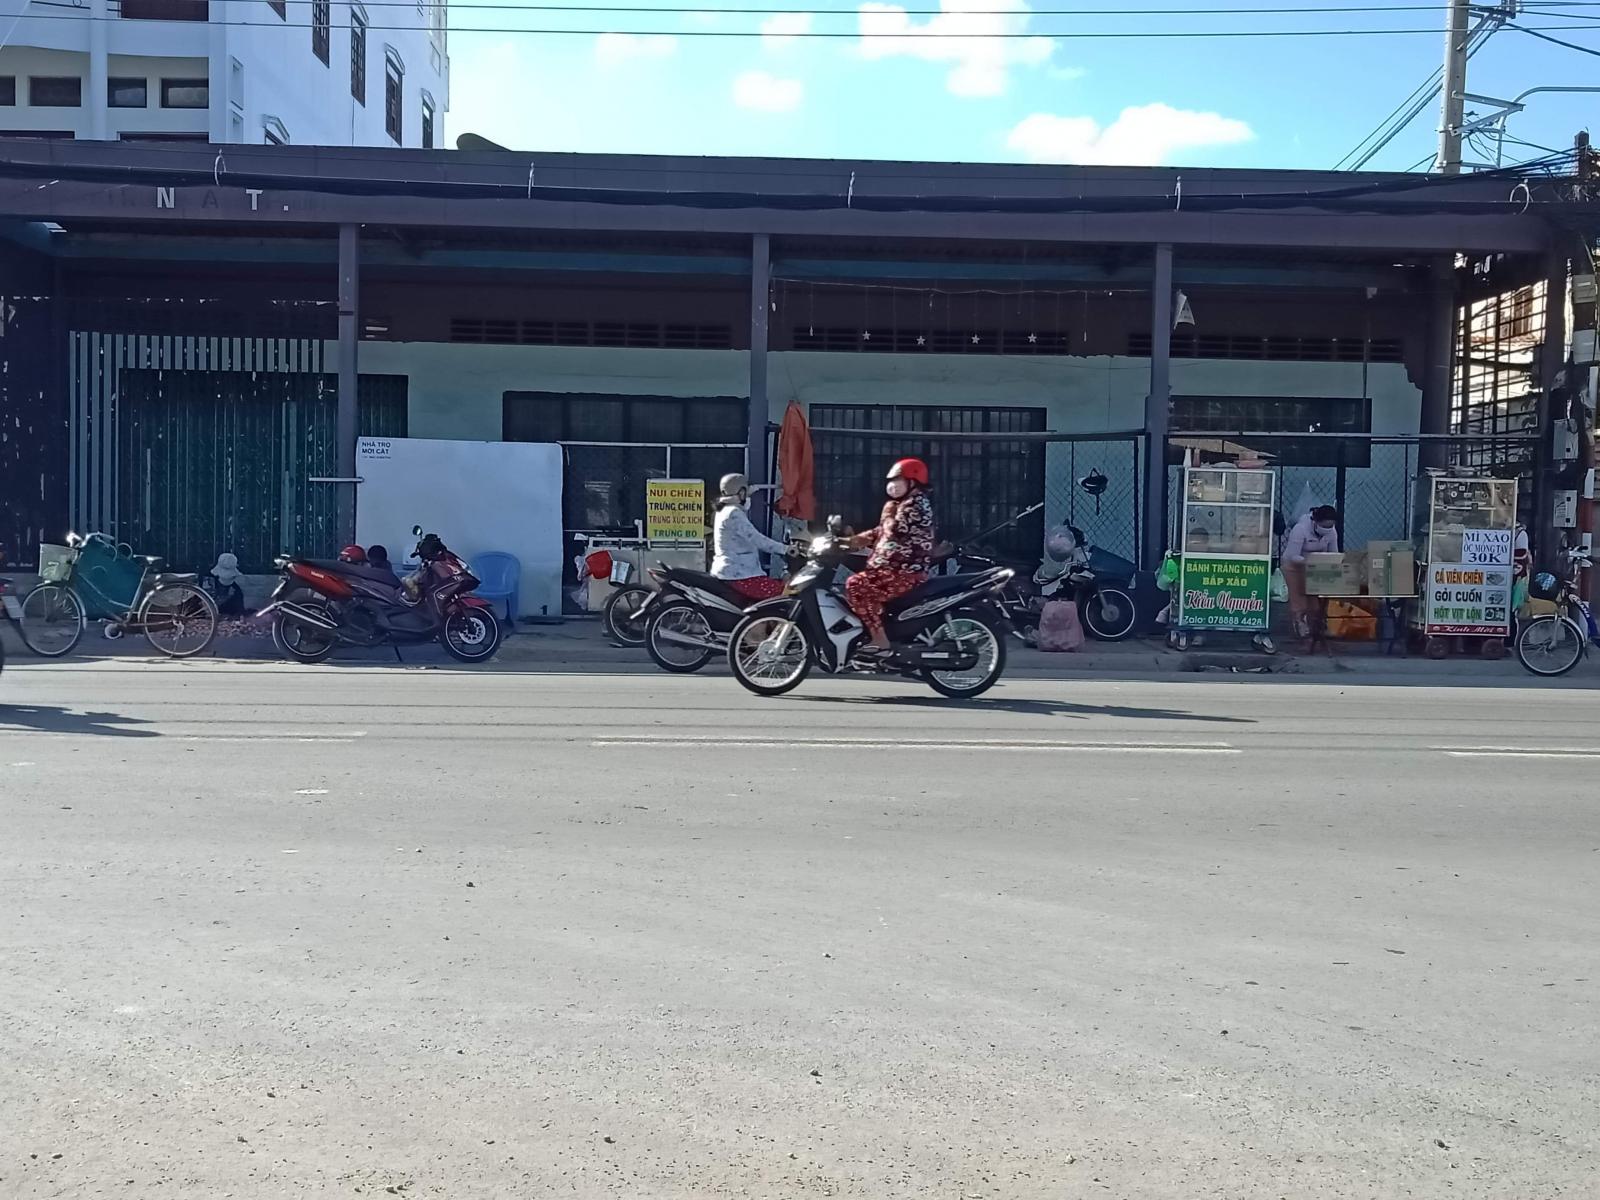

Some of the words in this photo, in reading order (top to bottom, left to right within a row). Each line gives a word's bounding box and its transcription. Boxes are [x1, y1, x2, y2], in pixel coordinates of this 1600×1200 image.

[650, 489, 667, 497] NUI
[1464, 531, 1480, 542] MÌ
[1483, 531, 1510, 543] XÀO
[1467, 552, 1502, 564] 30K
[1434, 588, 1452, 602] GỎI
[1455, 588, 1483, 603] CUỐN
